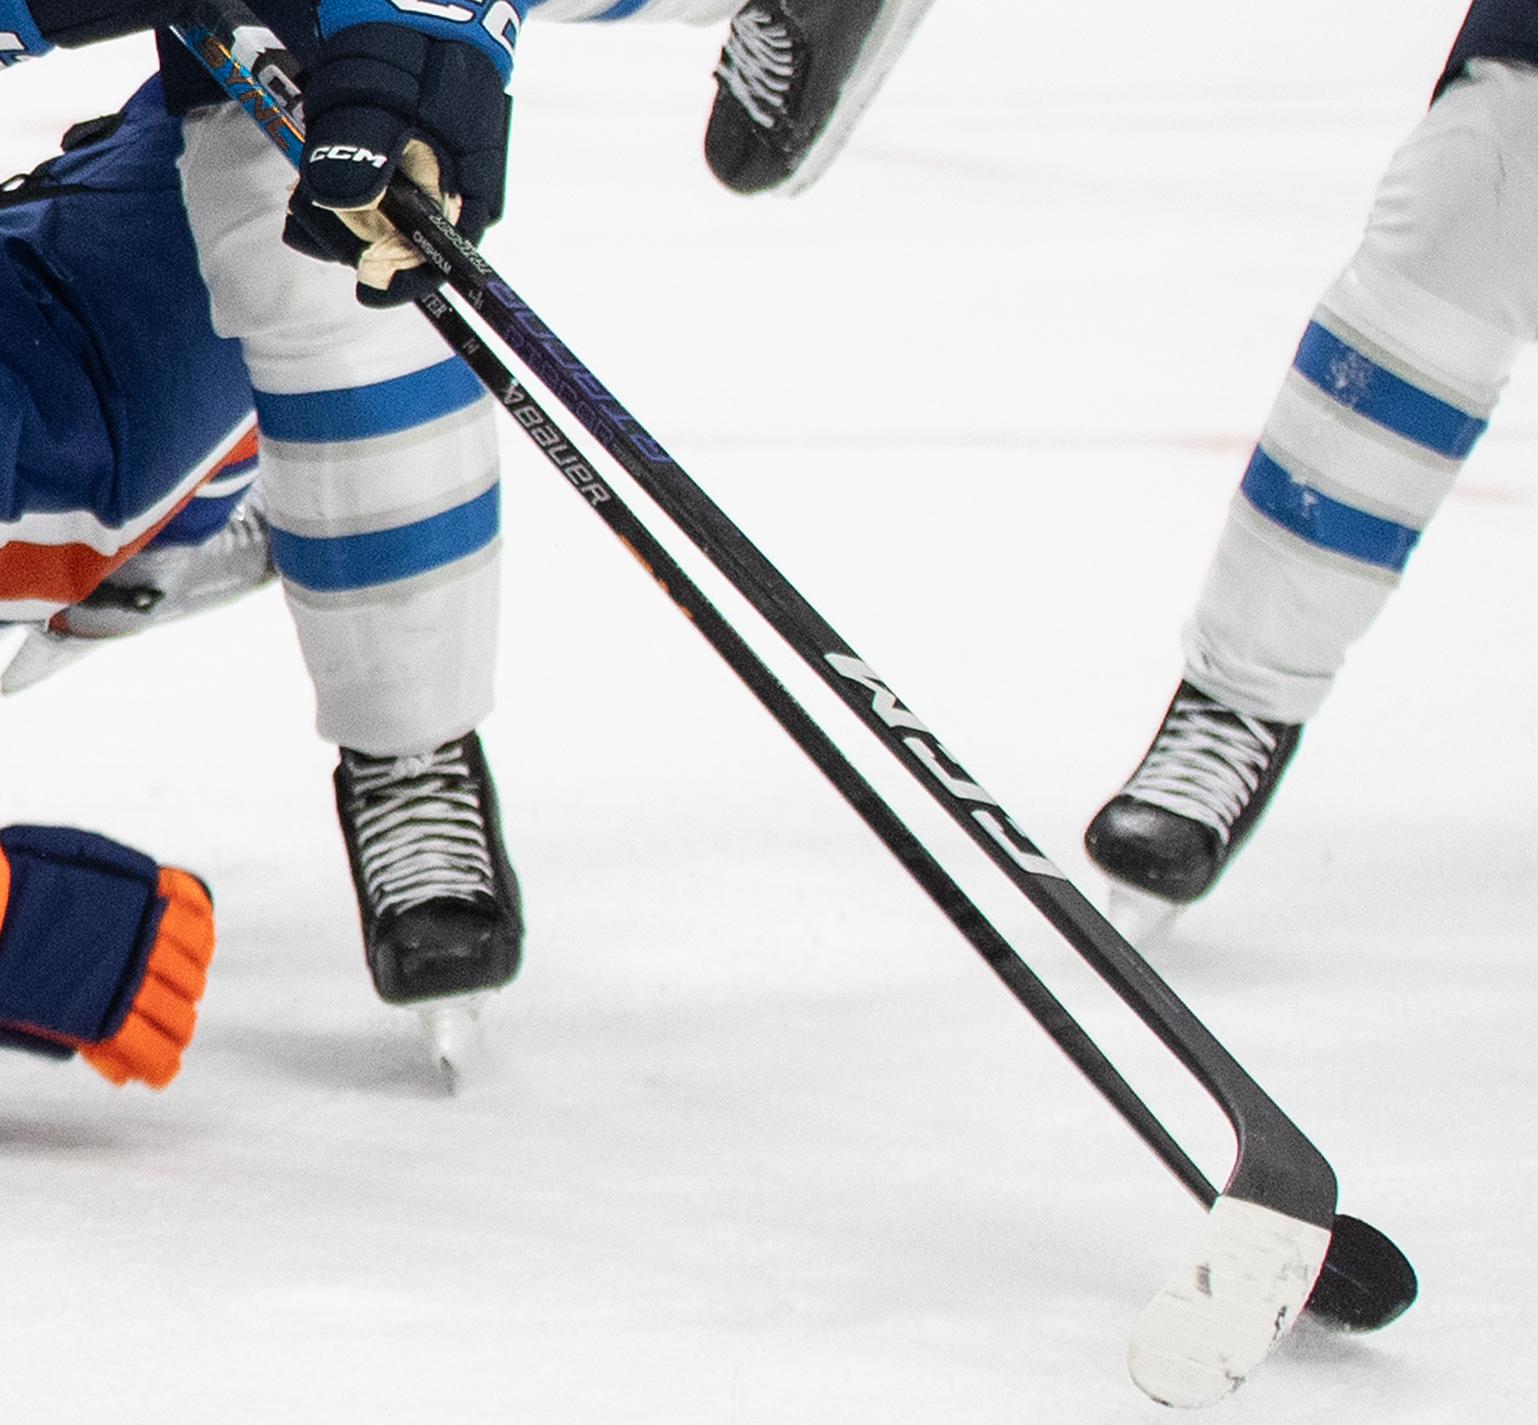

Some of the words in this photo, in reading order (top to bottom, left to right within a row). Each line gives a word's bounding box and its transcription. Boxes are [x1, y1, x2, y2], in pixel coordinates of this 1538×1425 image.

[308, 144, 388, 170] CCM
[412, 229, 453, 275] CHISHOLM
[821, 649, 1071, 882] CCM
